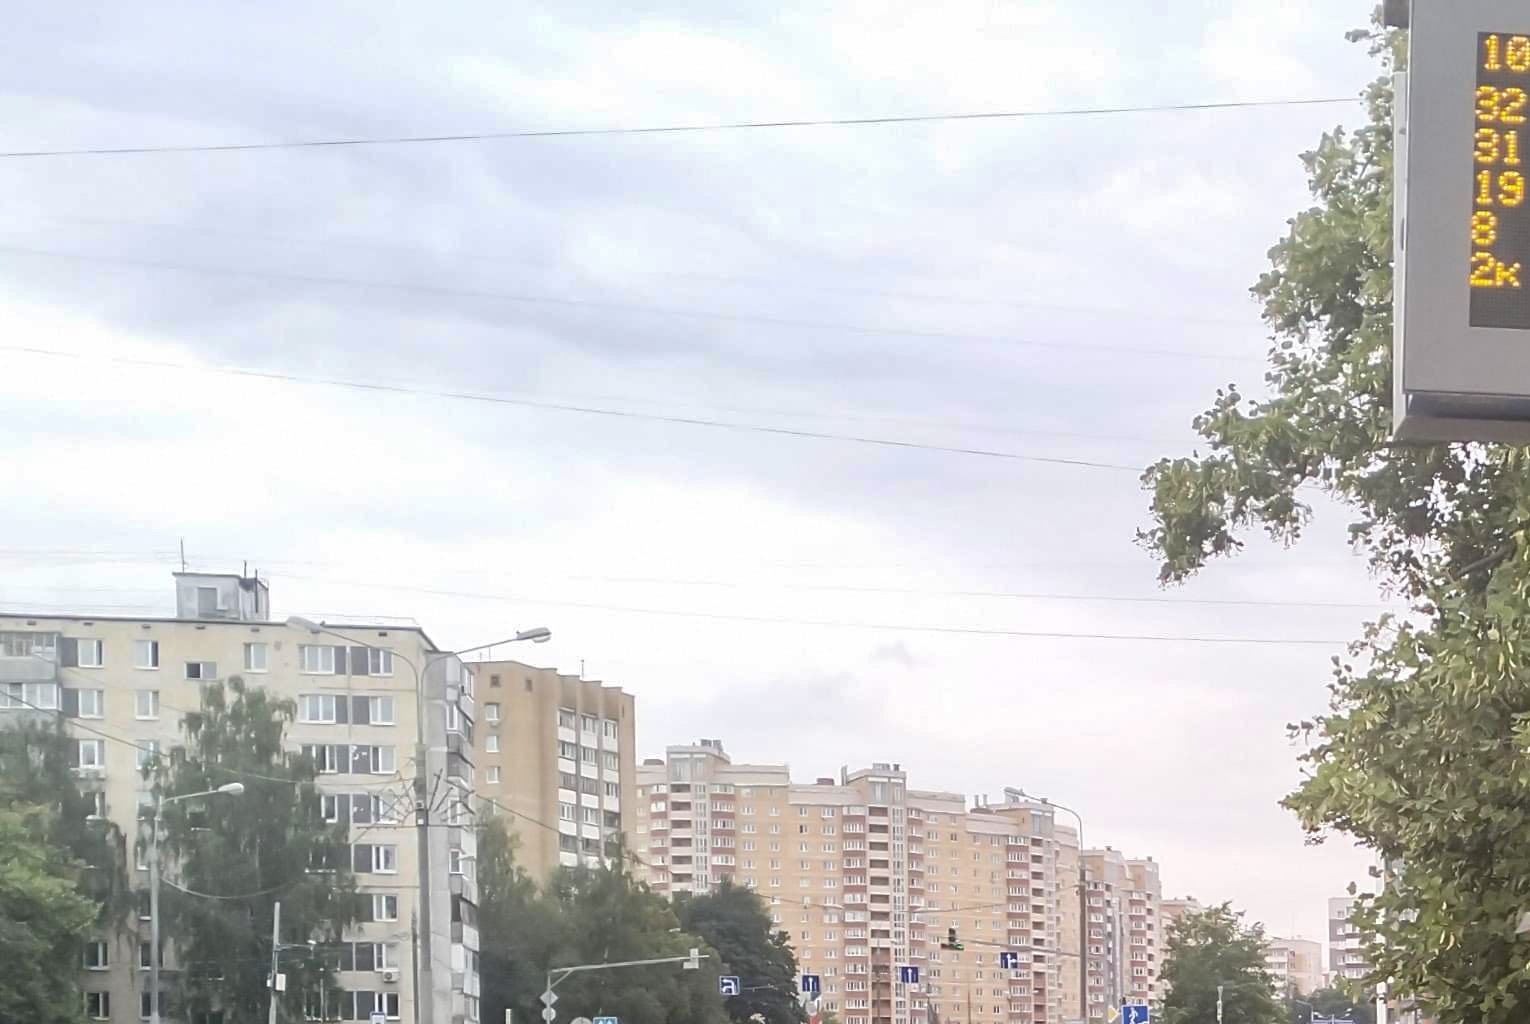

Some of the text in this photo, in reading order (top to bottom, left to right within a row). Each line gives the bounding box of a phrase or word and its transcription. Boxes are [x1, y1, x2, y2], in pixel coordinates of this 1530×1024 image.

[1475, 85, 1528, 125] 32
[1472, 127, 1521, 166] 31
[1475, 169, 1525, 207] 19
[1470, 210, 1498, 247] 8
[1467, 251, 1521, 288] 2к
